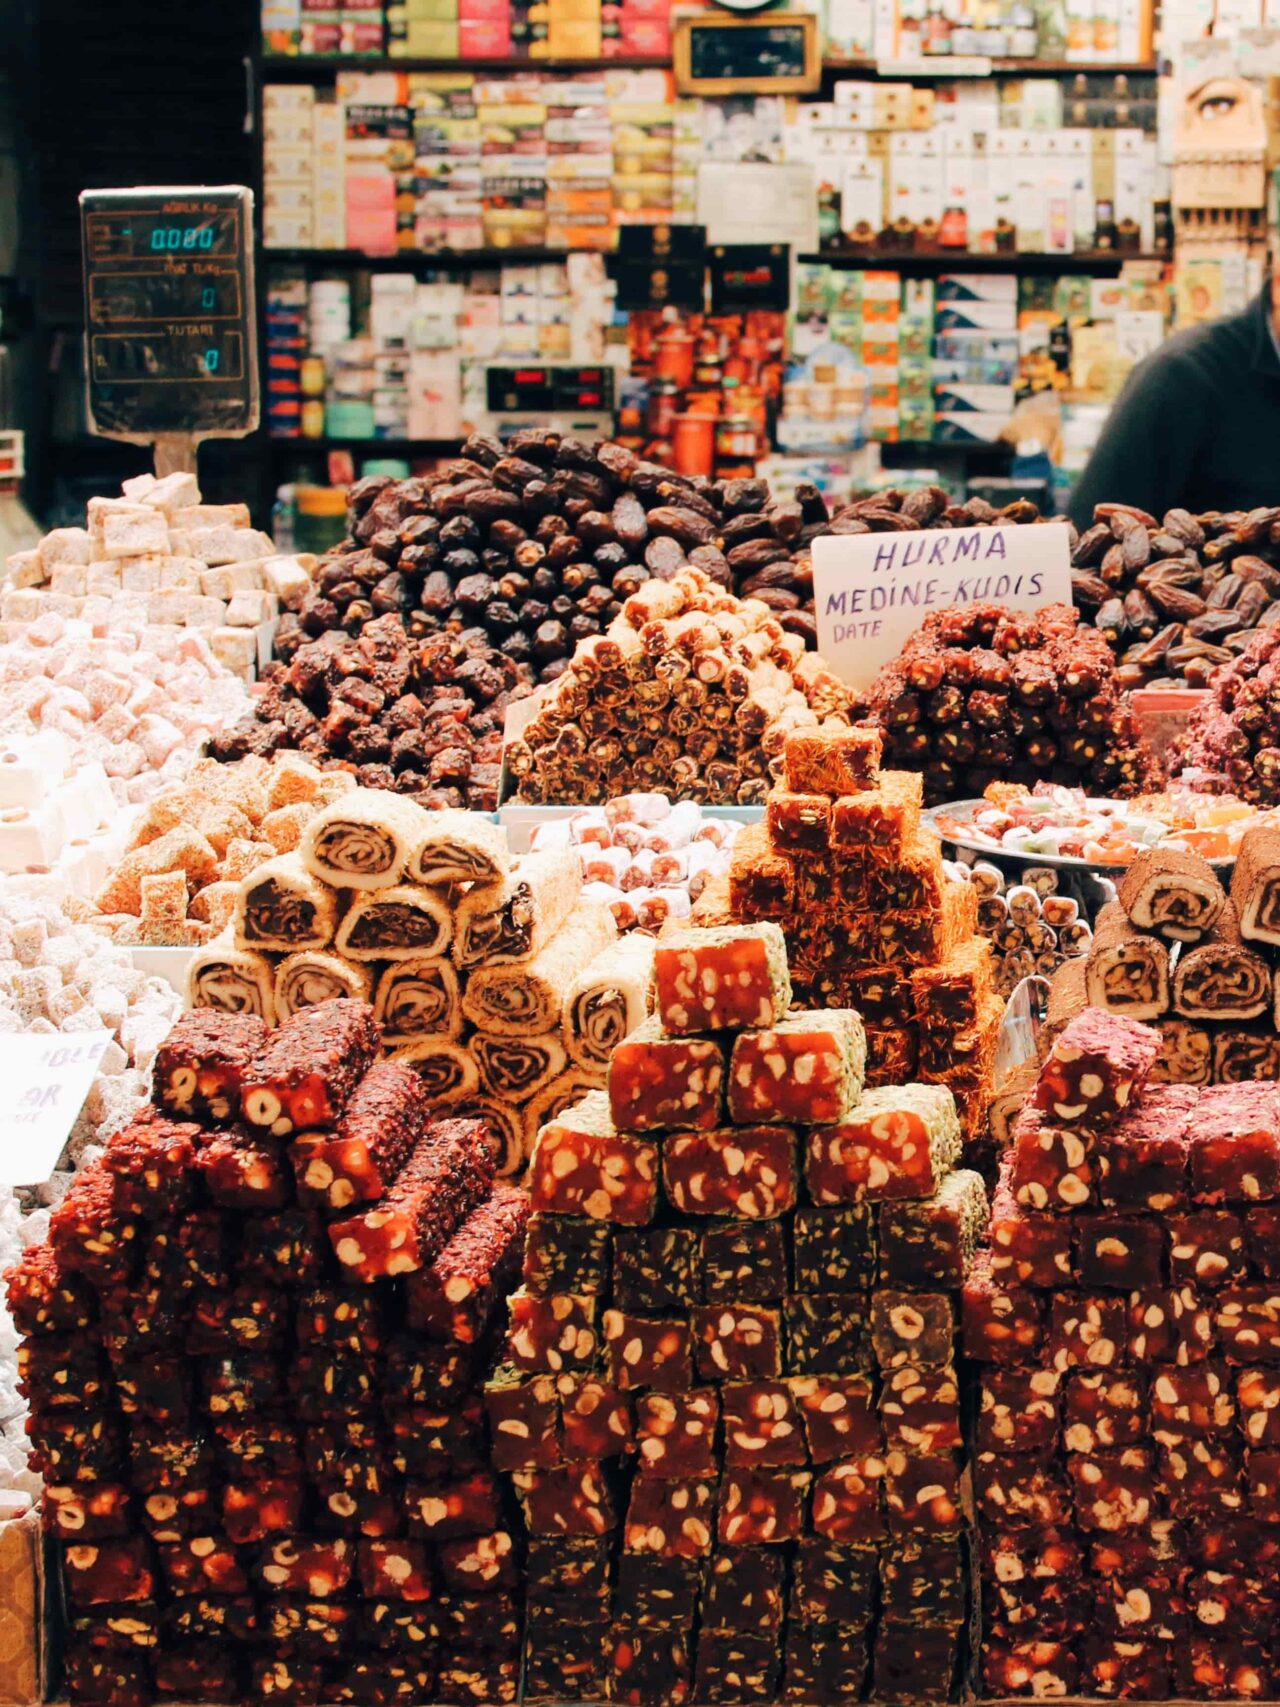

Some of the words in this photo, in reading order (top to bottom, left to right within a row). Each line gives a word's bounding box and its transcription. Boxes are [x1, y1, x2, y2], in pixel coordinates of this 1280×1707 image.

[205, 350, 218, 370] 0
[872, 531, 1007, 572] HURMA
[833, 620, 882, 644] DATE
